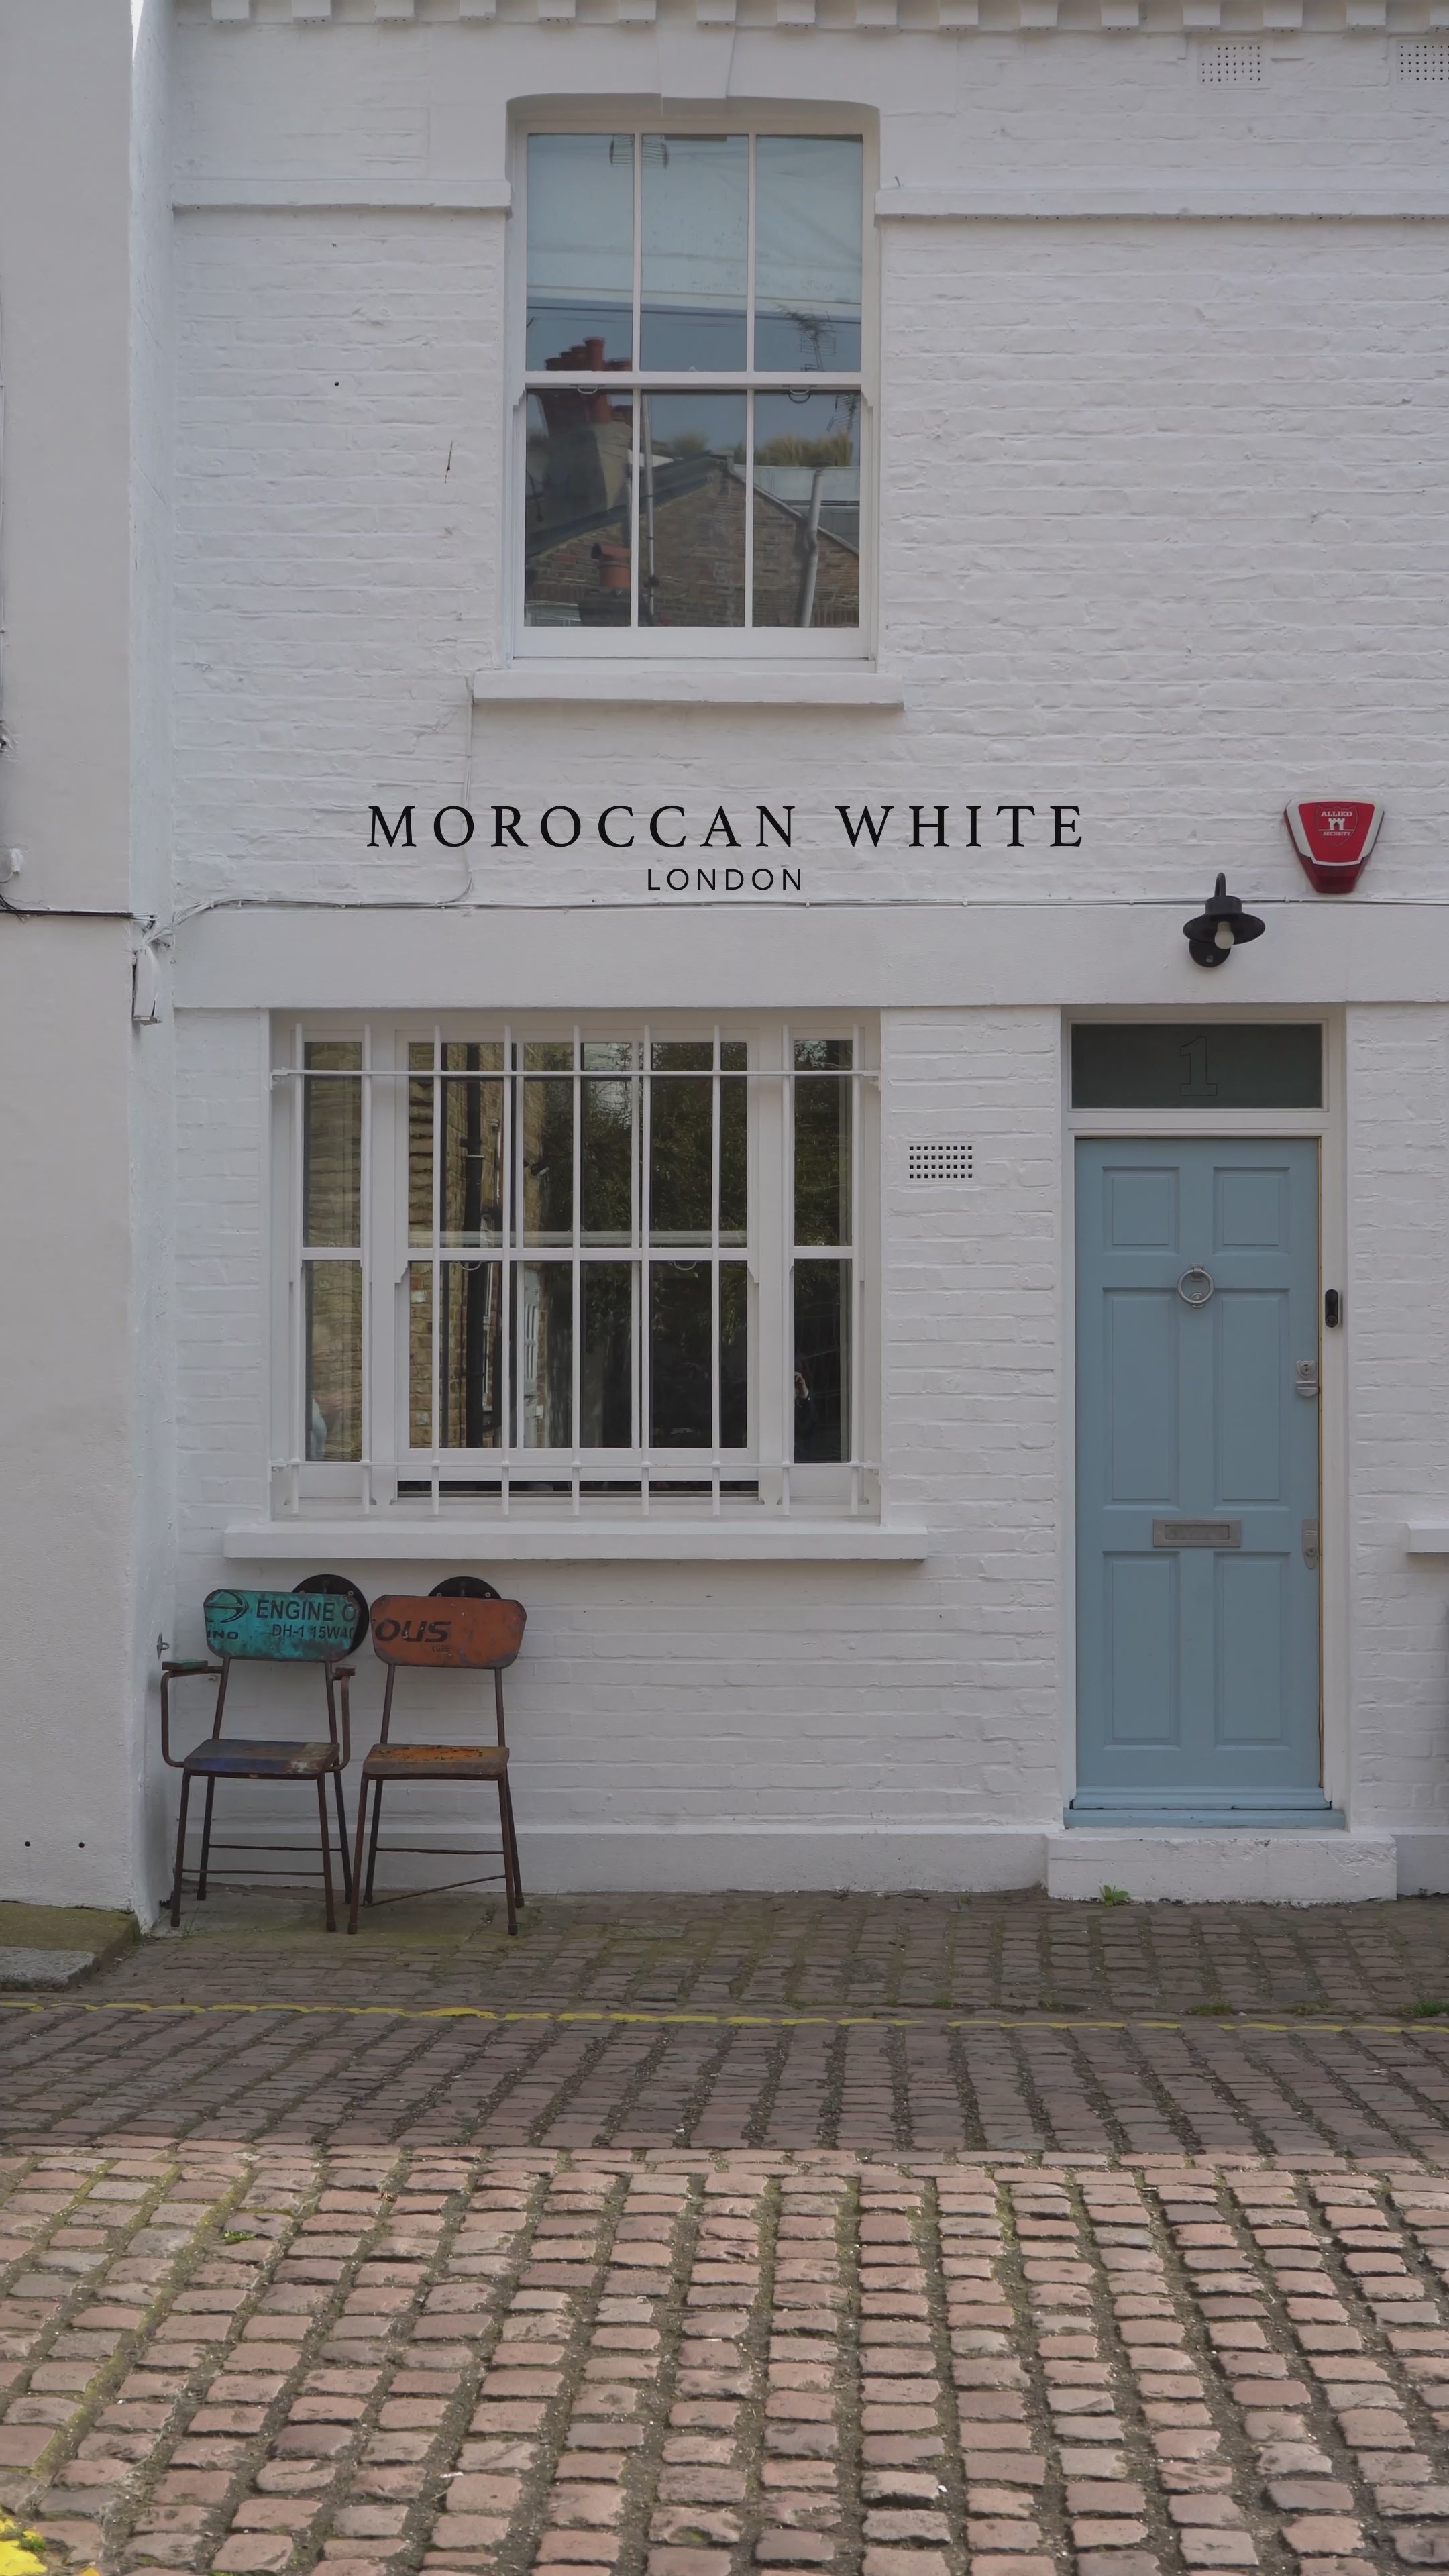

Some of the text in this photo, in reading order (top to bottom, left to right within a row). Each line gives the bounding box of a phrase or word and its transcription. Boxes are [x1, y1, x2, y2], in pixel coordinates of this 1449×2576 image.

[366, 806, 1083, 847] MOROCCAN WHITE
[647, 868, 801, 891] LONDON
[1179, 1036, 1218, 1096] 1
[256, 1599, 335, 1621] ENGINE
[272, 1623, 305, 1638] DH-1
[372, 1619, 451, 1643] OUS
